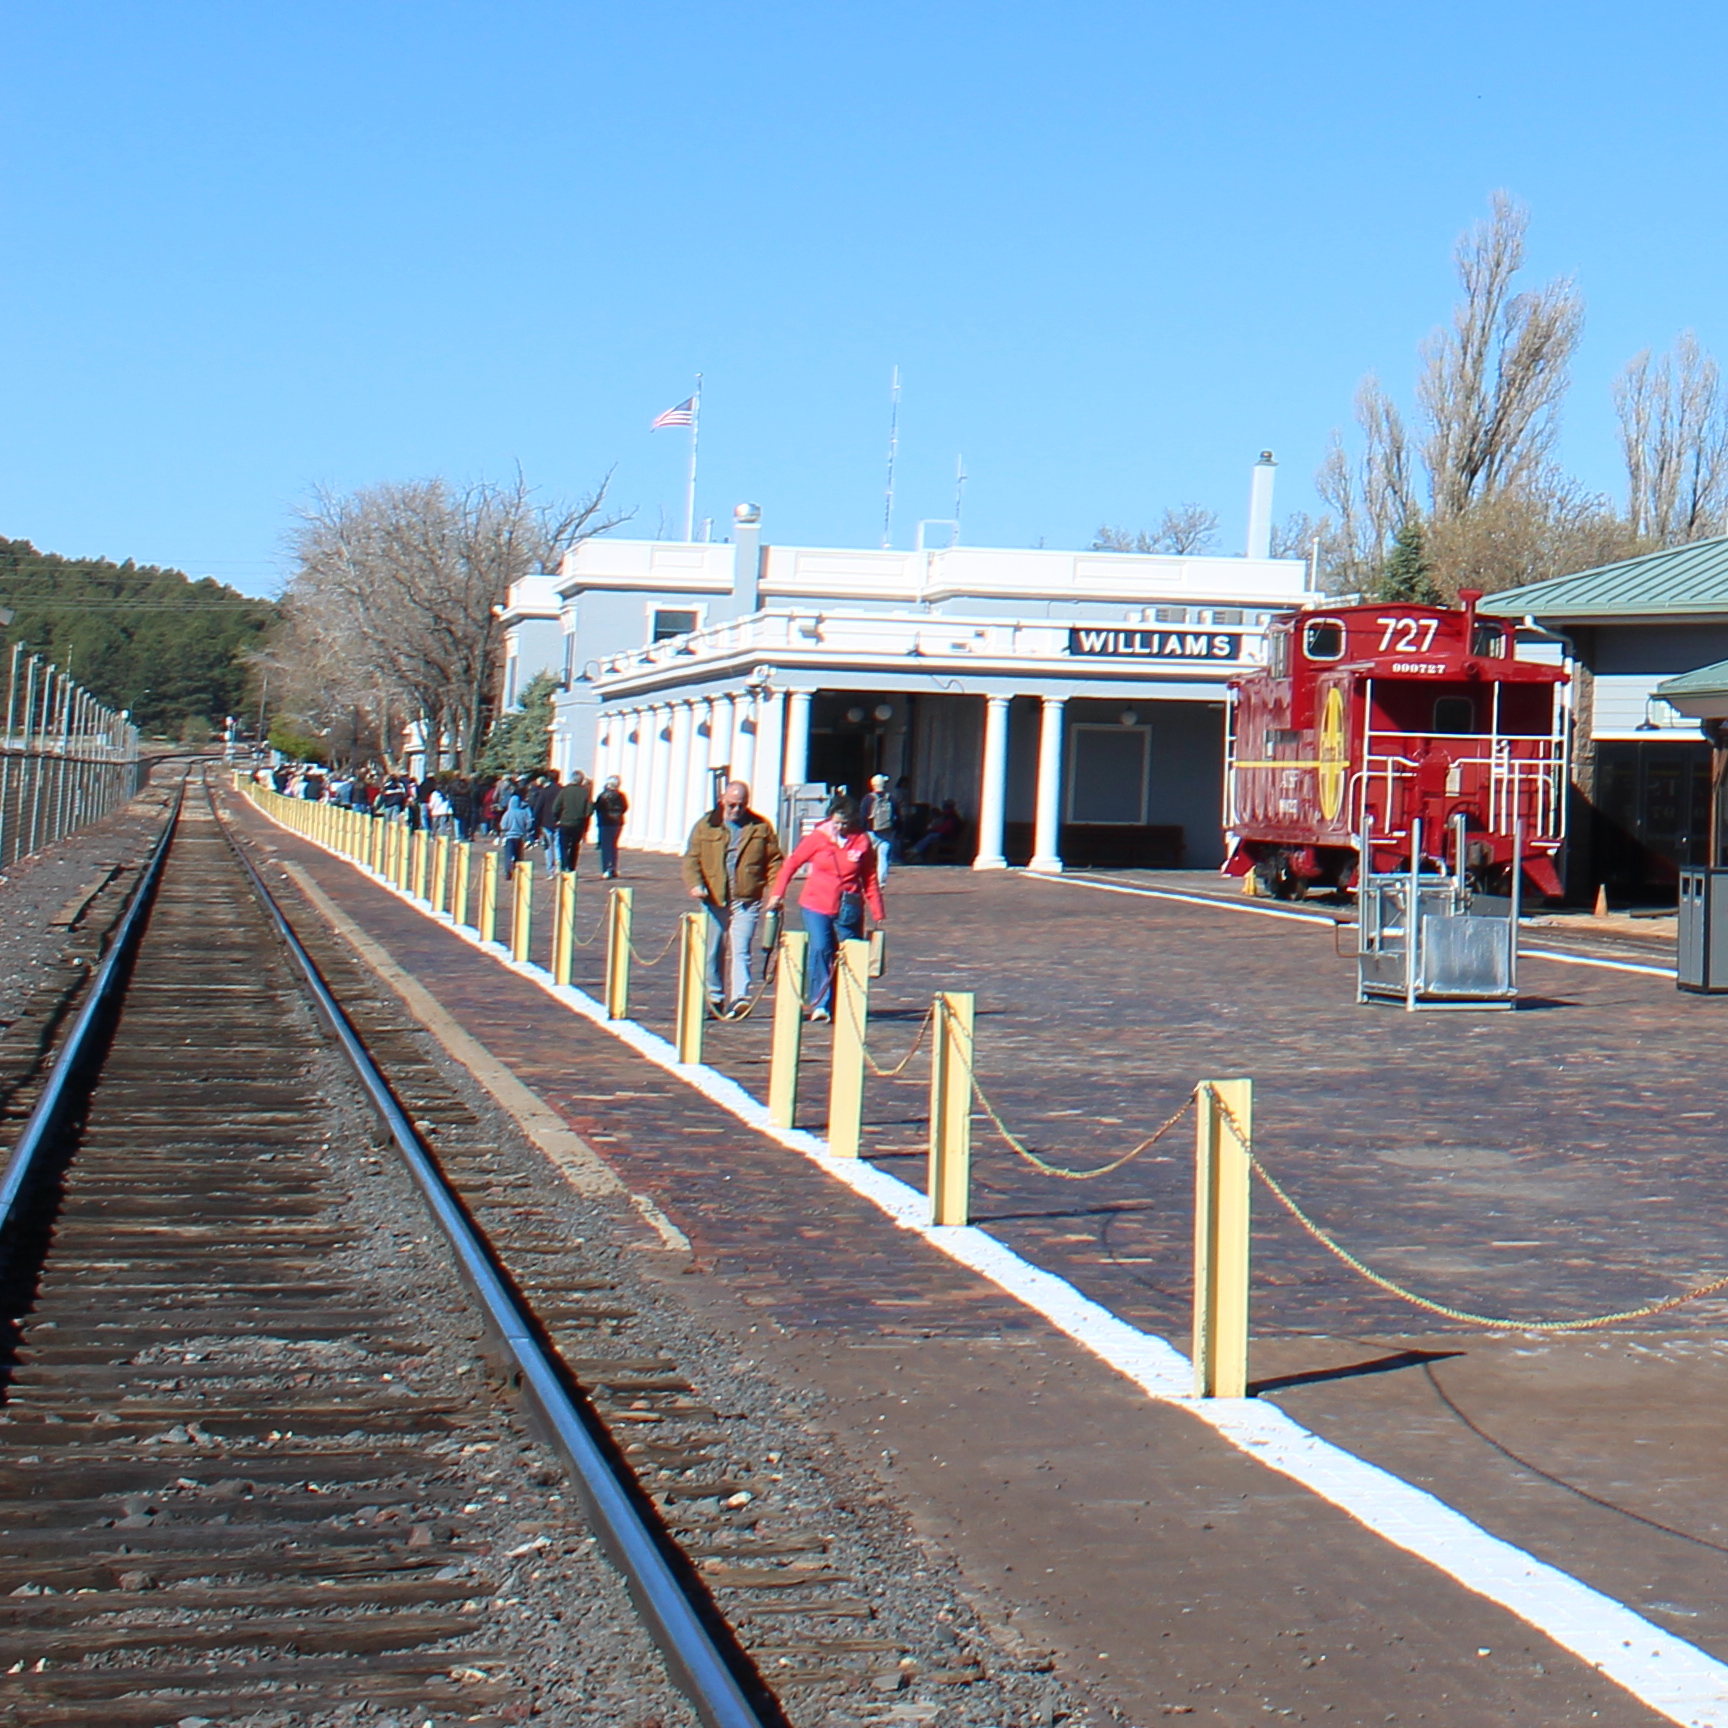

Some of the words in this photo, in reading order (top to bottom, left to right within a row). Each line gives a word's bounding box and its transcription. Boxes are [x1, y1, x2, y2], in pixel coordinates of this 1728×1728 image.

[1078, 630, 1232, 657] WILLIAMS
[1375, 617, 1440, 652] 727
[1391, 662, 1446, 674] 000727
